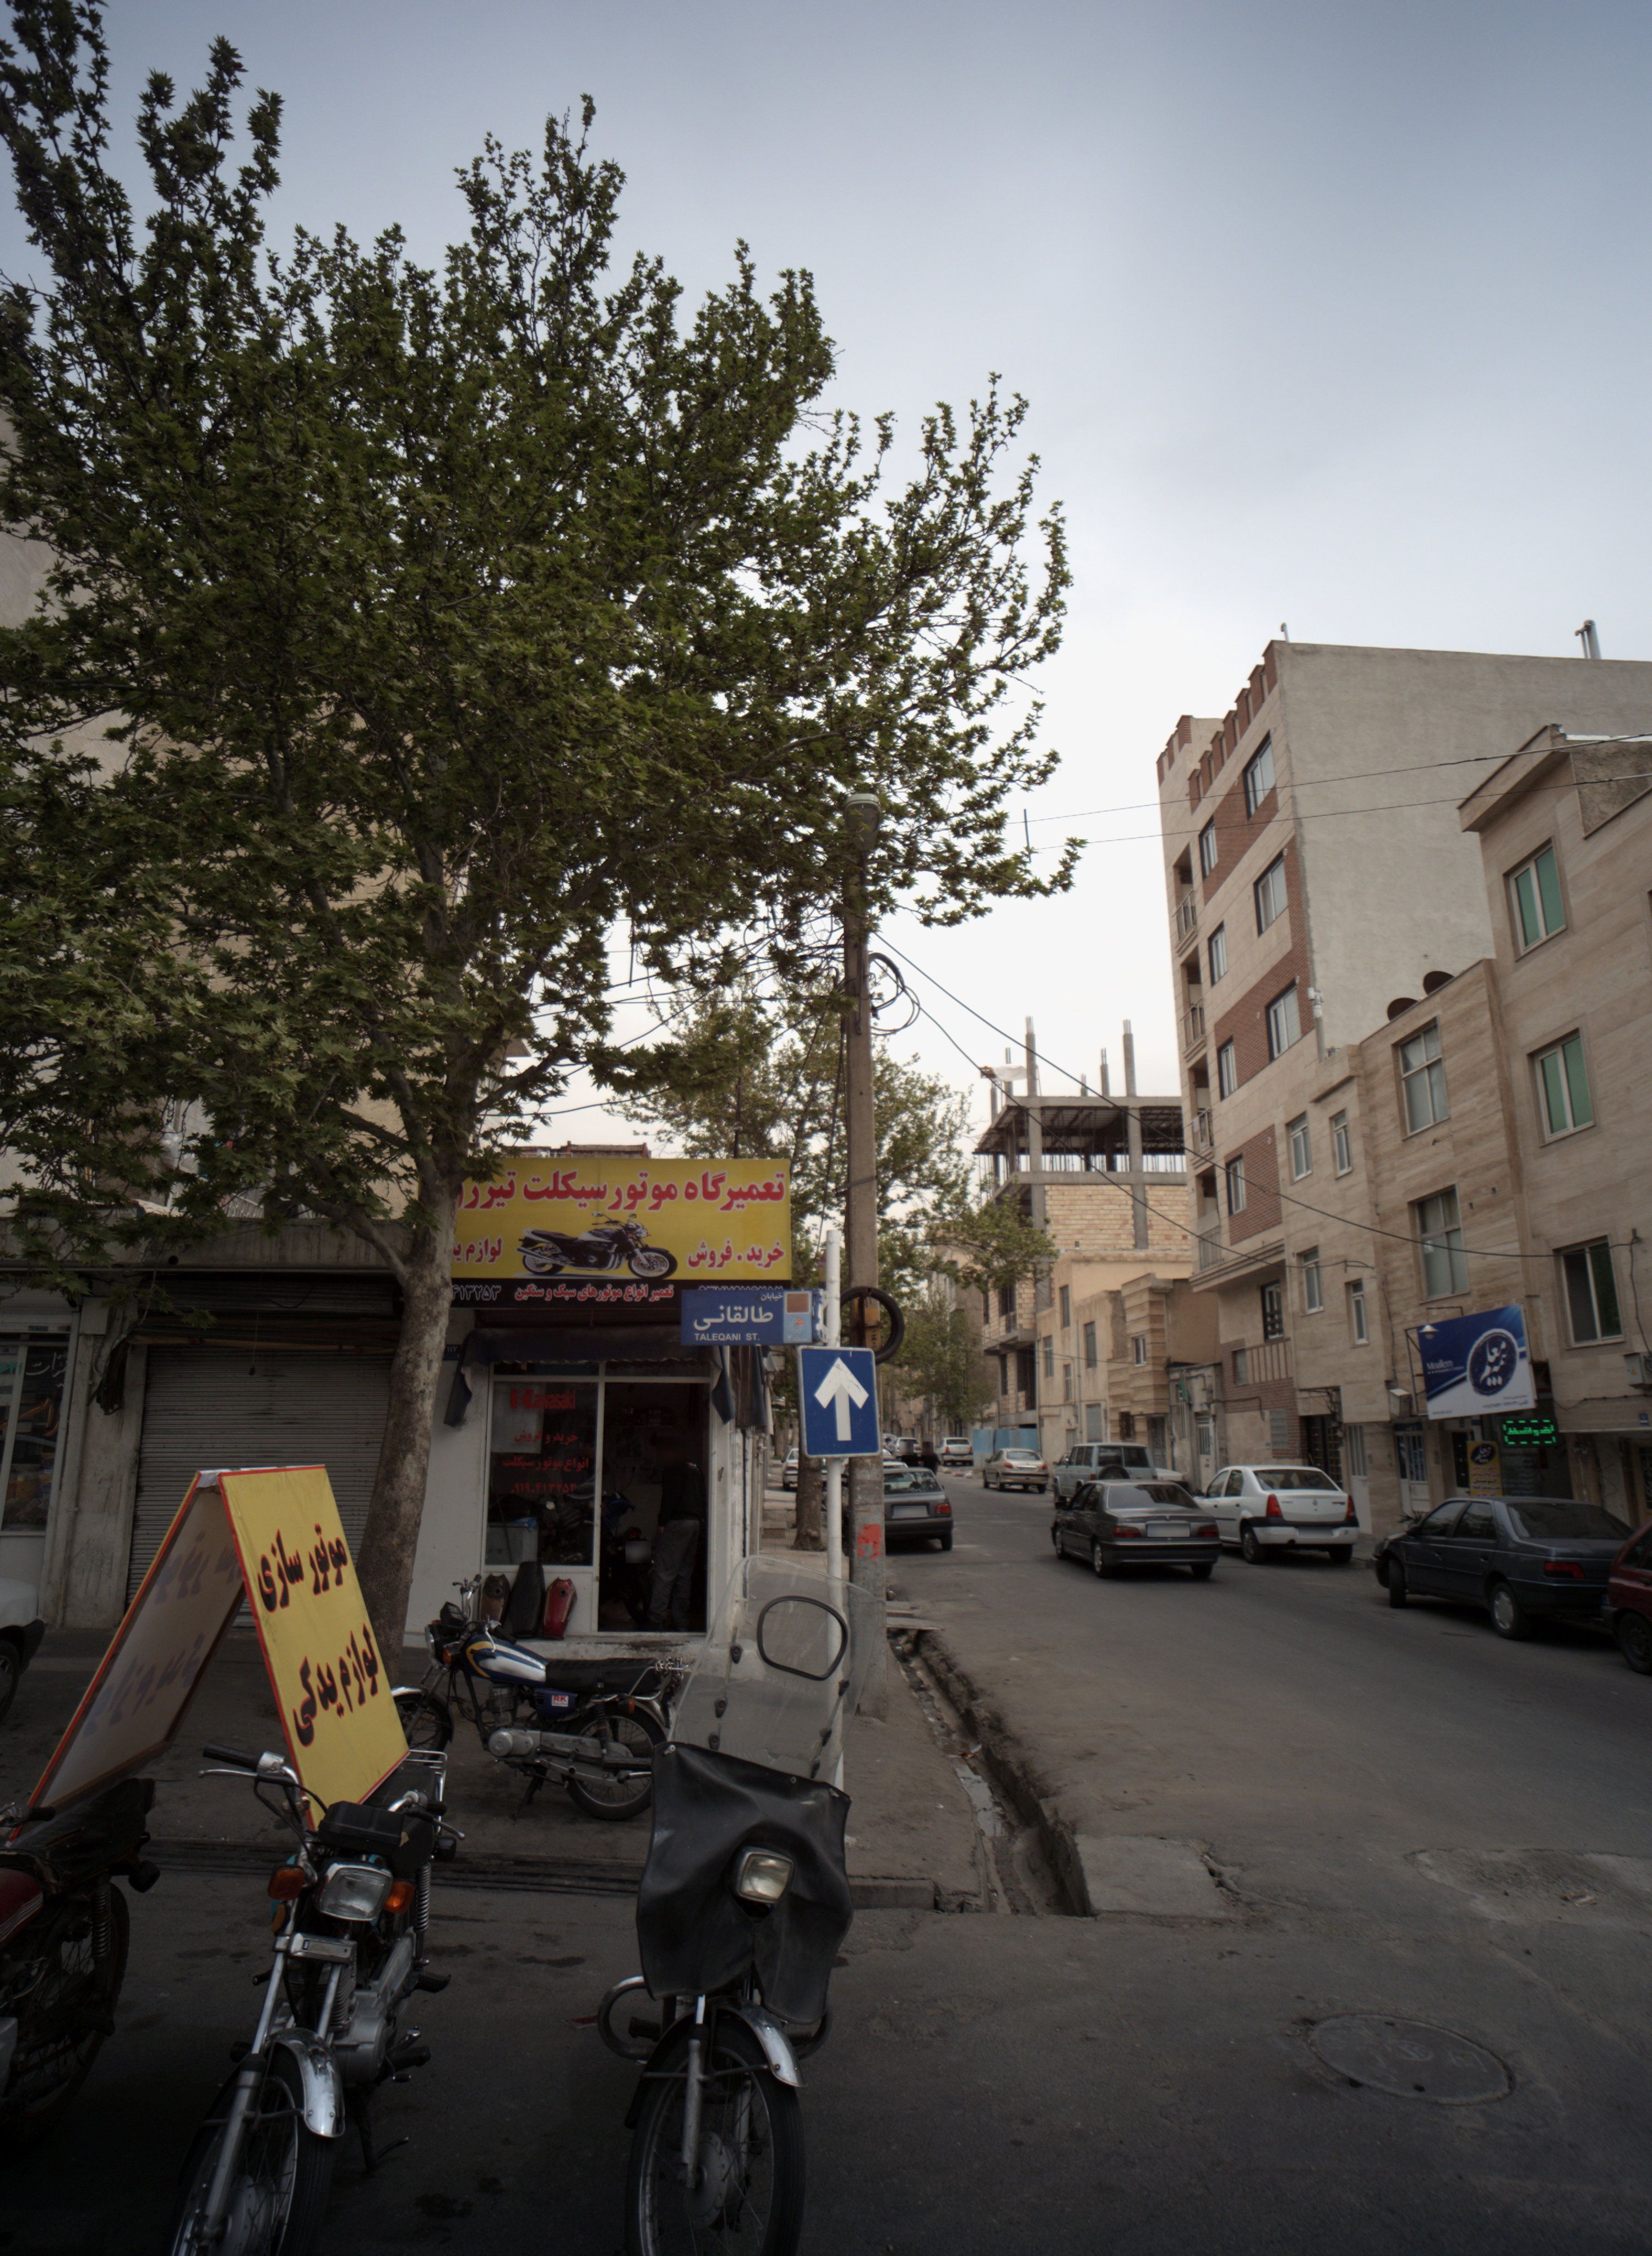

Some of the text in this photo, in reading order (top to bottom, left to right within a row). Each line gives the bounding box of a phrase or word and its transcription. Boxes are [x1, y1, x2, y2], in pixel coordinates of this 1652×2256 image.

[523, 1169, 607, 1208] سیکلت
[607, 1172, 677, 1211] موتور
[684, 1171, 785, 1211] تعمیرگاه
[465, 1237, 502, 1263] لوازم
[688, 1240, 732, 1268] فروش
[747, 1241, 784, 1268] خرید
[514, 1283, 545, 1301] سنگین
[545, 1288, 552, 1301] و
[553, 1283, 577, 1301] سبک
[623, 1283, 649, 1301] انواع
[649, 1284, 675, 1301] تعمیر
[760, 1292, 784, 1301] خیابان
[693, 1304, 774, 1331] طالقانی
[694, 1333, 760, 1341] TALEQANI ST.
[510, 1389, 576, 1409] Kawasaki
[514, 1429, 579, 1446] خرید و فروش
[563, 1455, 589, 1472] انواع
[257, 1528, 304, 1613] سازی
[308, 1523, 348, 1596] موتور
[339, 1623, 378, 1714] لوازم
[292, 1655, 345, 1748] یدکی
